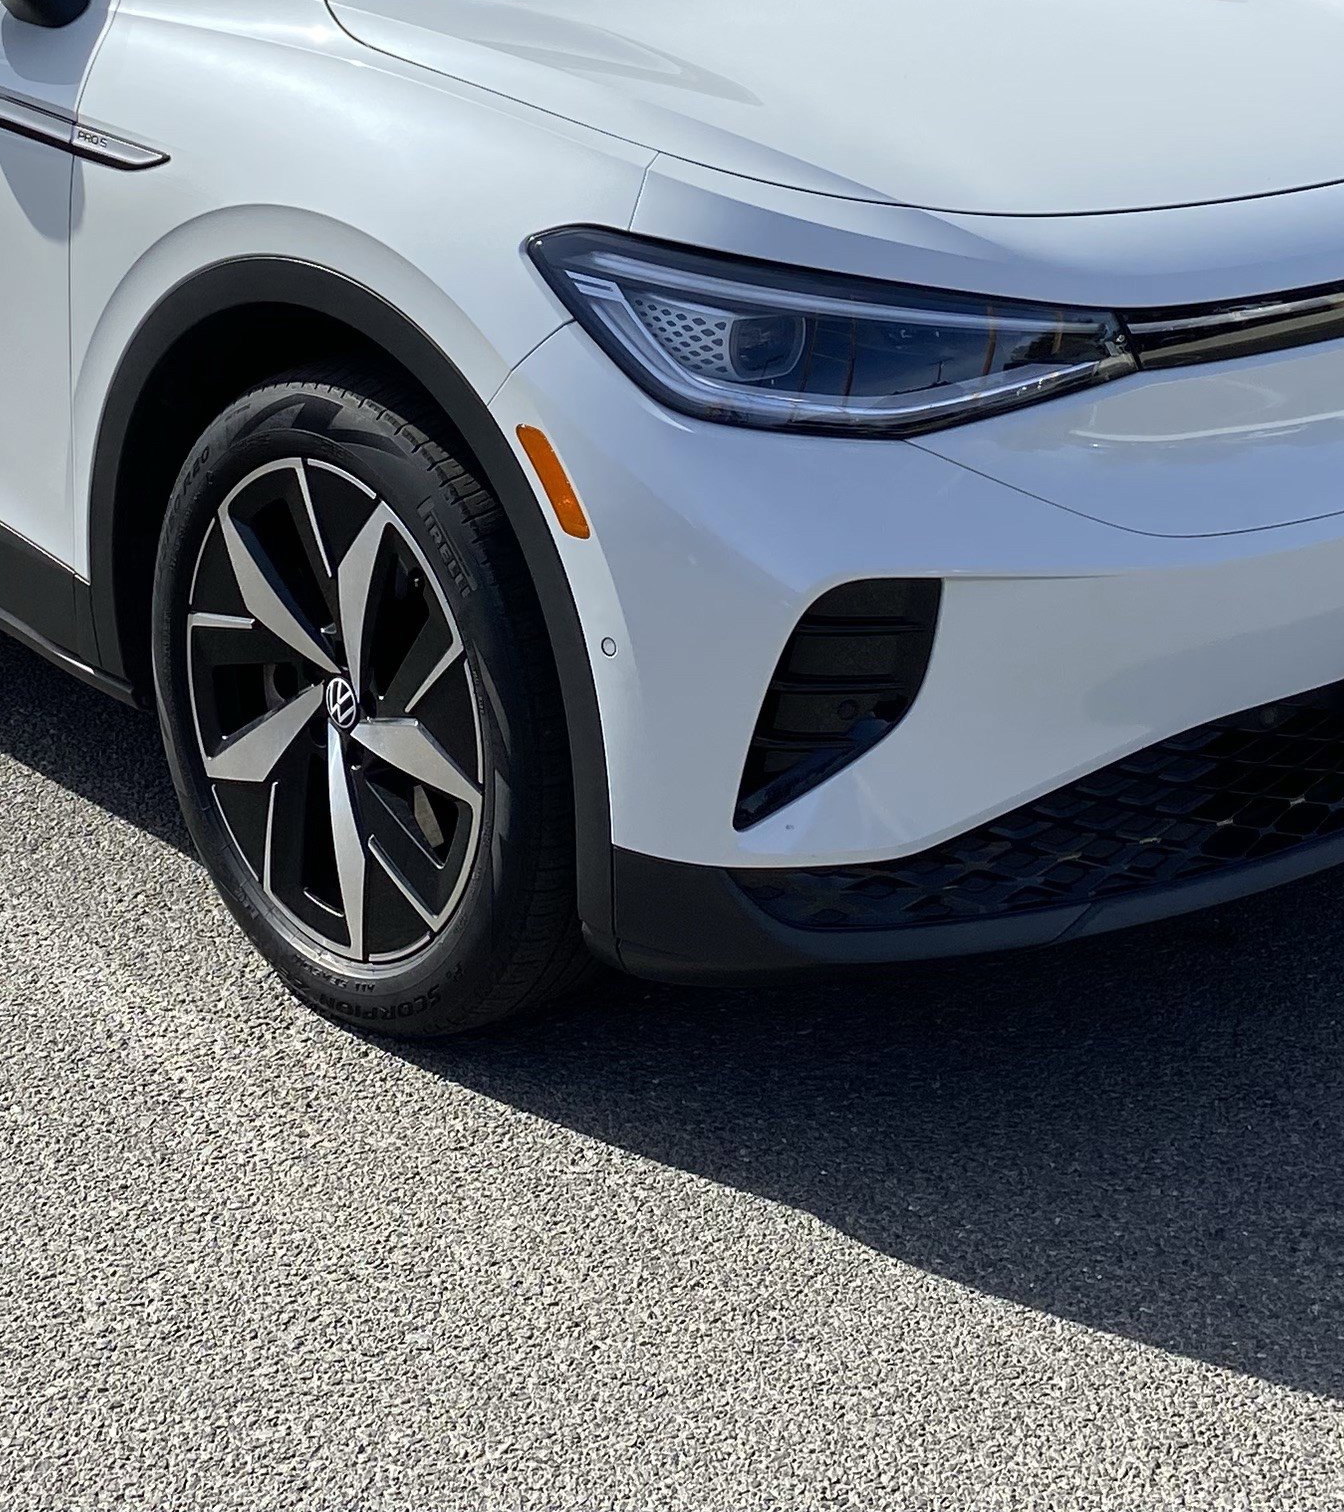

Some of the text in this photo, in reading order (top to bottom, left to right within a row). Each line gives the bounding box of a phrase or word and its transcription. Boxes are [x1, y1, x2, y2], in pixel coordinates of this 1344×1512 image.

[77, 130, 108, 148] PRO S
[417, 495, 477, 598] PIRELLI
